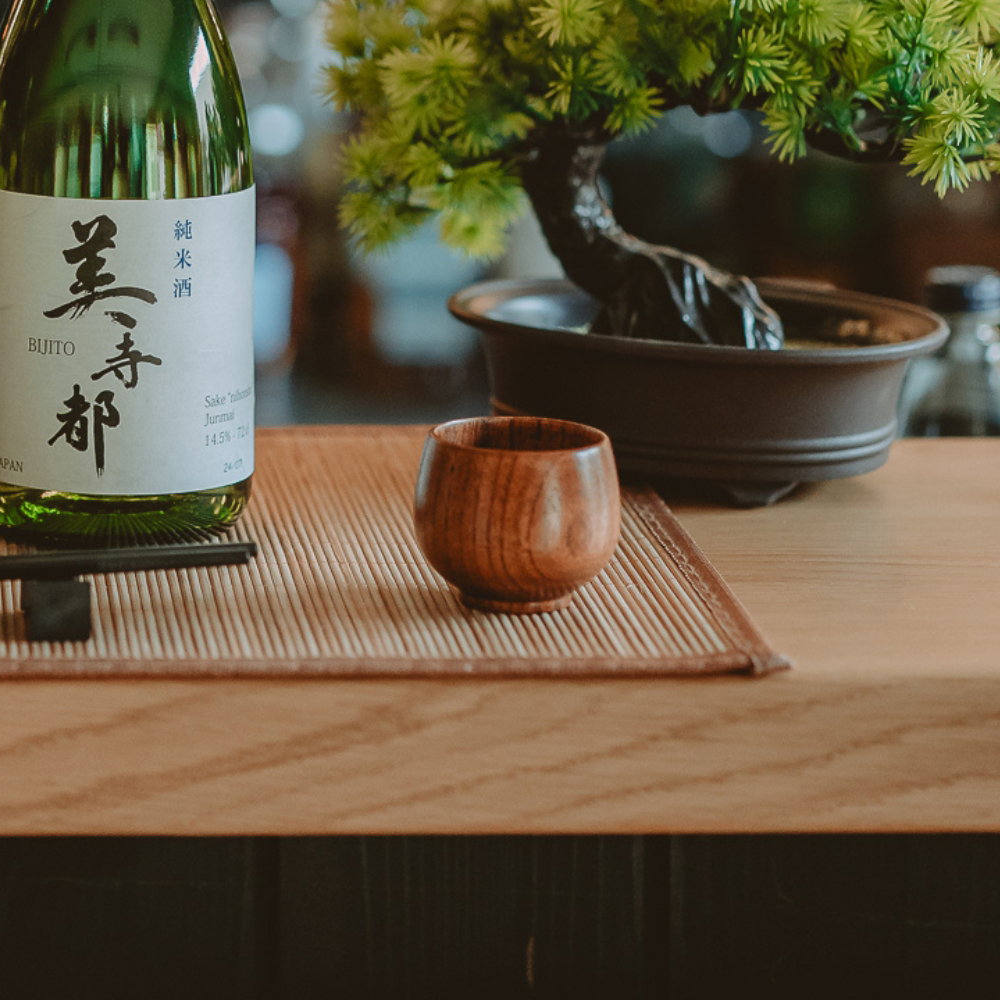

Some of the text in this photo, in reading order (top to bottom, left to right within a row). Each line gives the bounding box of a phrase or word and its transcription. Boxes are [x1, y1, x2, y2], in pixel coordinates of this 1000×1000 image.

[173, 219, 193, 298] 純米酒
[27, 336, 76, 356] BIJITO
[204, 394, 226, 408] Sake
[203, 409, 235, 427] Junmai
[204, 430, 231, 447] 14.5%
